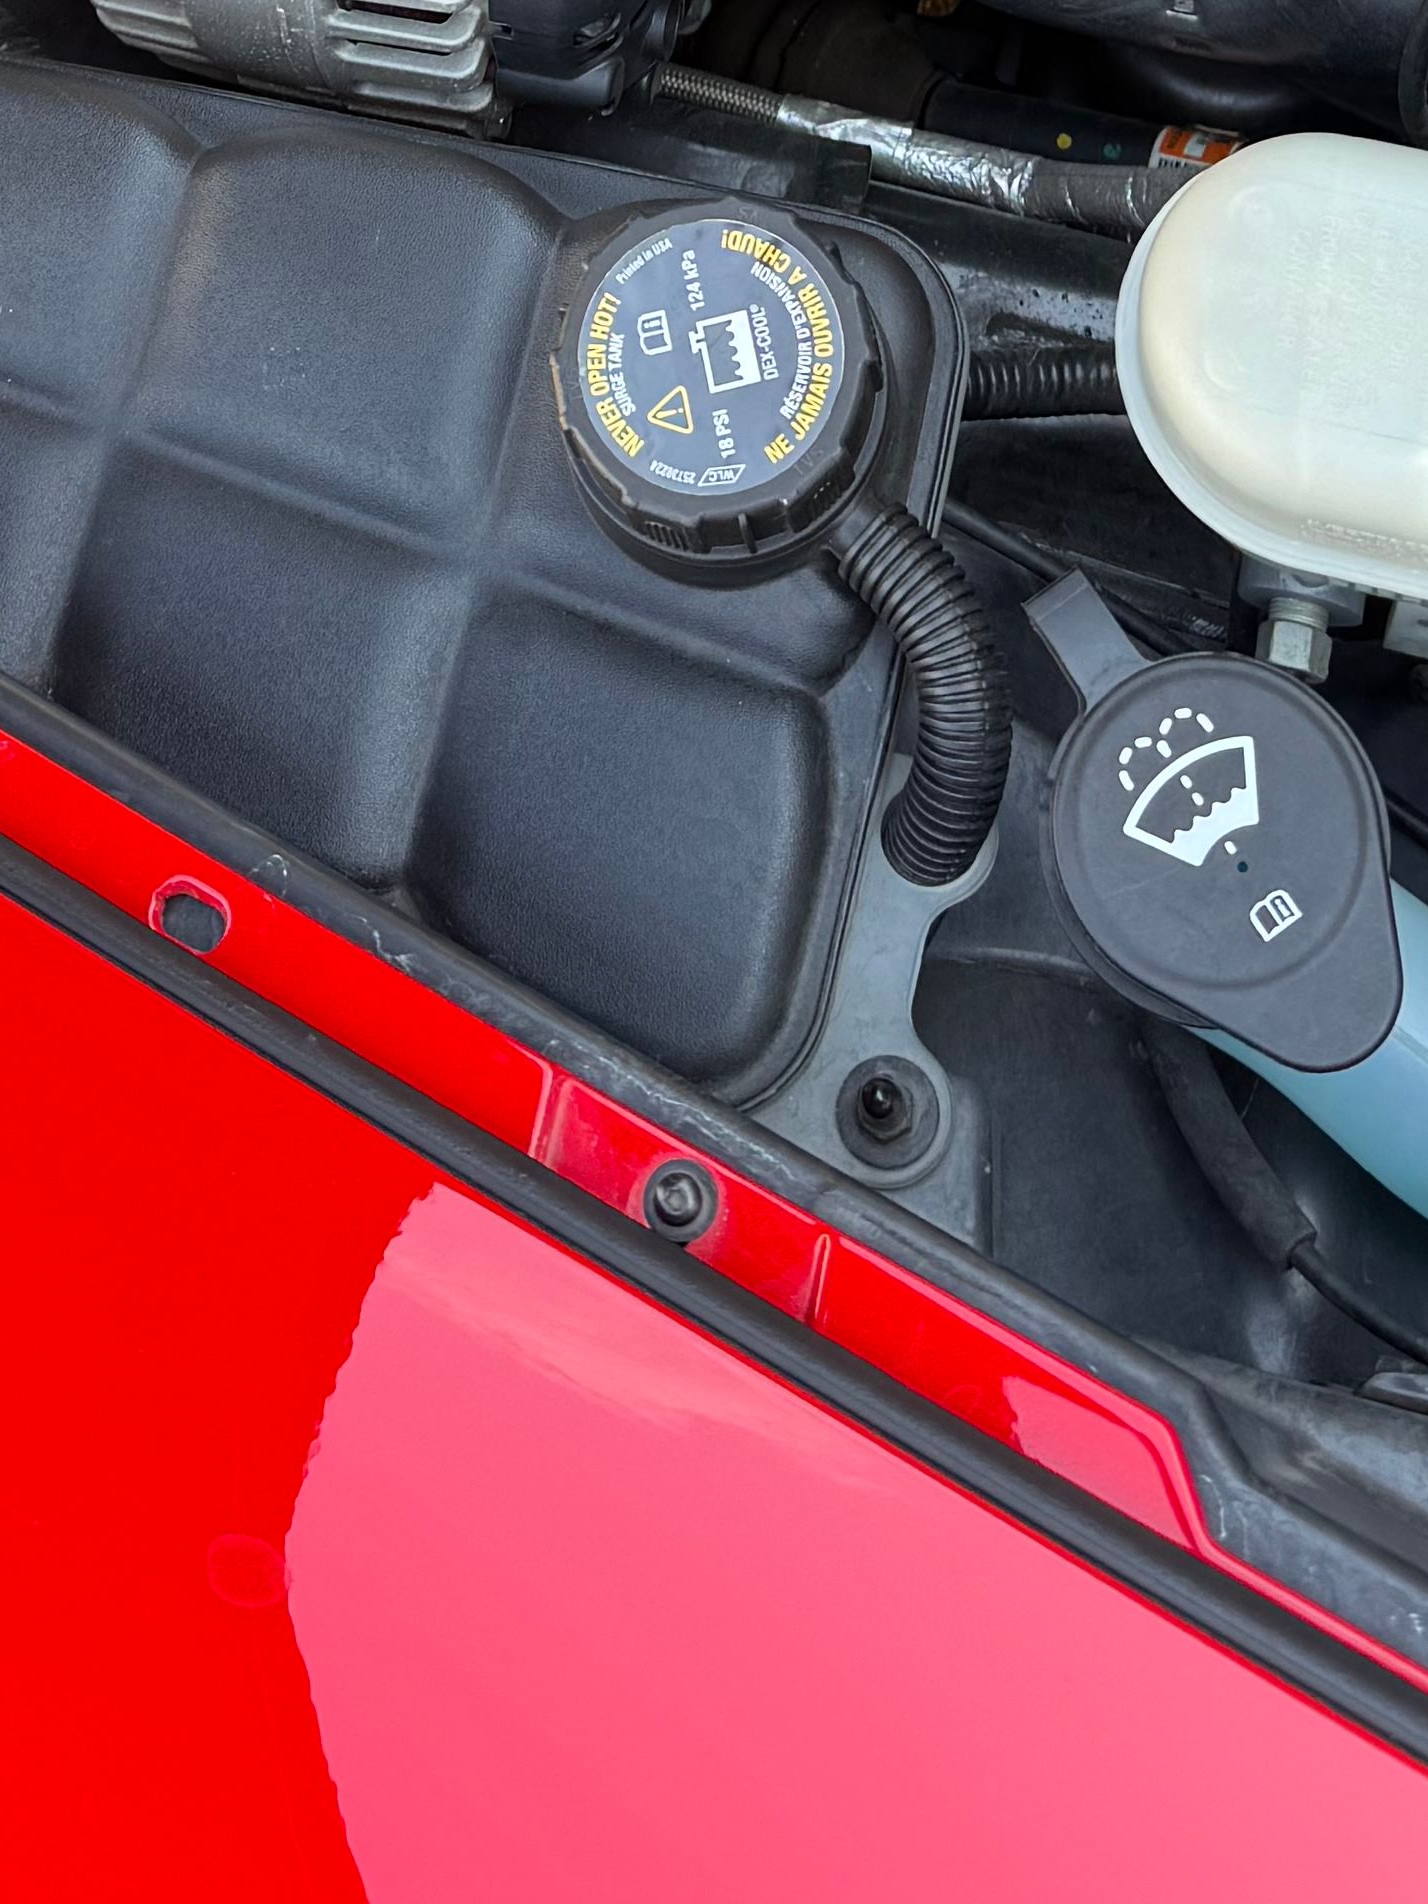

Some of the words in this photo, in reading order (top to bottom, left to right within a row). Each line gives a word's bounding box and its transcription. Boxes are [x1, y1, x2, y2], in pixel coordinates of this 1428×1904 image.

[615, 255, 645, 285] Printed
[651, 237, 673, 256] USA
[681, 250, 700, 282] kPa
[721, 229, 794, 272] CHAUD!
[588, 292, 622, 343] HOT!
[686, 284, 706, 311] 124
[750, 262, 808, 340] D'EXPANSION
[798, 287, 834, 357] OUVRIR
[586, 344, 611, 396] OPEN
[608, 333, 626, 366] TANK
[608, 369, 637, 417] SURGE
[780, 344, 813, 420] RÉSERVOIR
[790, 362, 833, 439] JAMAIS
[595, 398, 646, 458] NEVER
[713, 409, 731, 435] PSI
[719, 435, 736, 459] 18
[764, 433, 794, 464] NE
[708, 468, 738, 483] WLC
